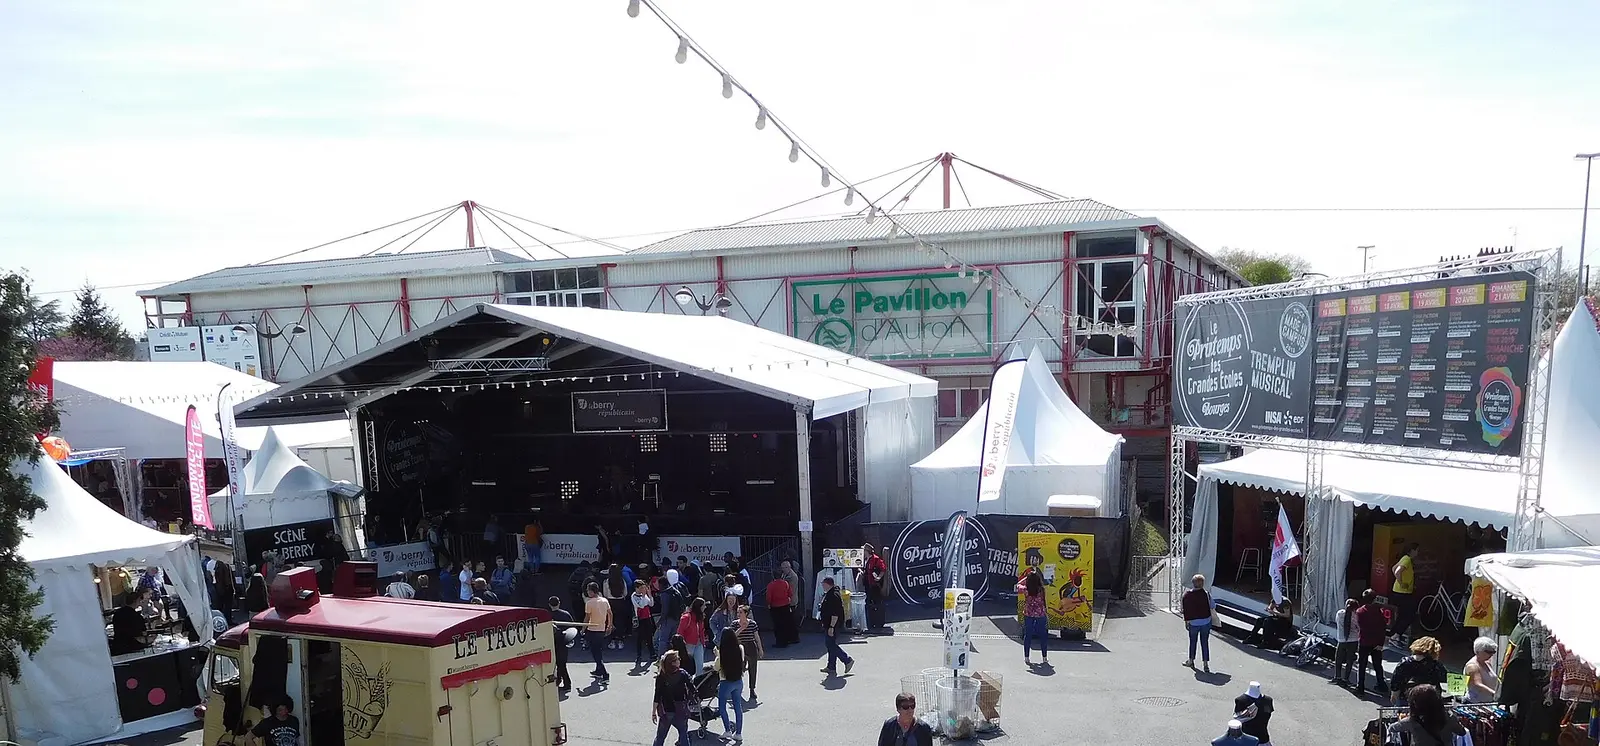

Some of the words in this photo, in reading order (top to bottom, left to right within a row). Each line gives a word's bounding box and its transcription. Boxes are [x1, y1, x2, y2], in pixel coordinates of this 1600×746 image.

[1456, 287, 1478, 295] SAMEDI
[1491, 283, 1523, 293] DIMANCHE
[813, 293, 846, 315] Le
[855, 287, 967, 314] Pavillon
[861, 318, 966, 342] d'Auron
[1210, 321, 1218, 335] Le
[1284, 314, 1301, 332] MADE
[1300, 323, 1308, 336] IN
[1281, 325, 1306, 348] CAMPUS
[1186, 334, 1242, 361] Printemps
[1210, 358, 1221, 373] des
[1250, 350, 1297, 380] TREMPLIN
[1187, 374, 1218, 395] Grandes
[1251, 370, 1291, 399] MUSICAL
[593, 401, 615, 410] berry
[1201, 402, 1230, 417] Bourges
[1265, 411, 1282, 424] INSA
[989, 422, 1004, 454] berry
[187, 441, 203, 523] SANDWICH
[273, 527, 307, 545] SCÈNE
[282, 543, 316, 560] BERRY
[401, 550, 425, 560] berry
[550, 540, 574, 553] berry
[687, 541, 712, 555] berry
[988, 548, 1019, 564] TREM
[989, 560, 1018, 577] MUSI
[907, 570, 942, 588] Grande
[452, 630, 478, 660] LE
[483, 617, 539, 652] TACOT
